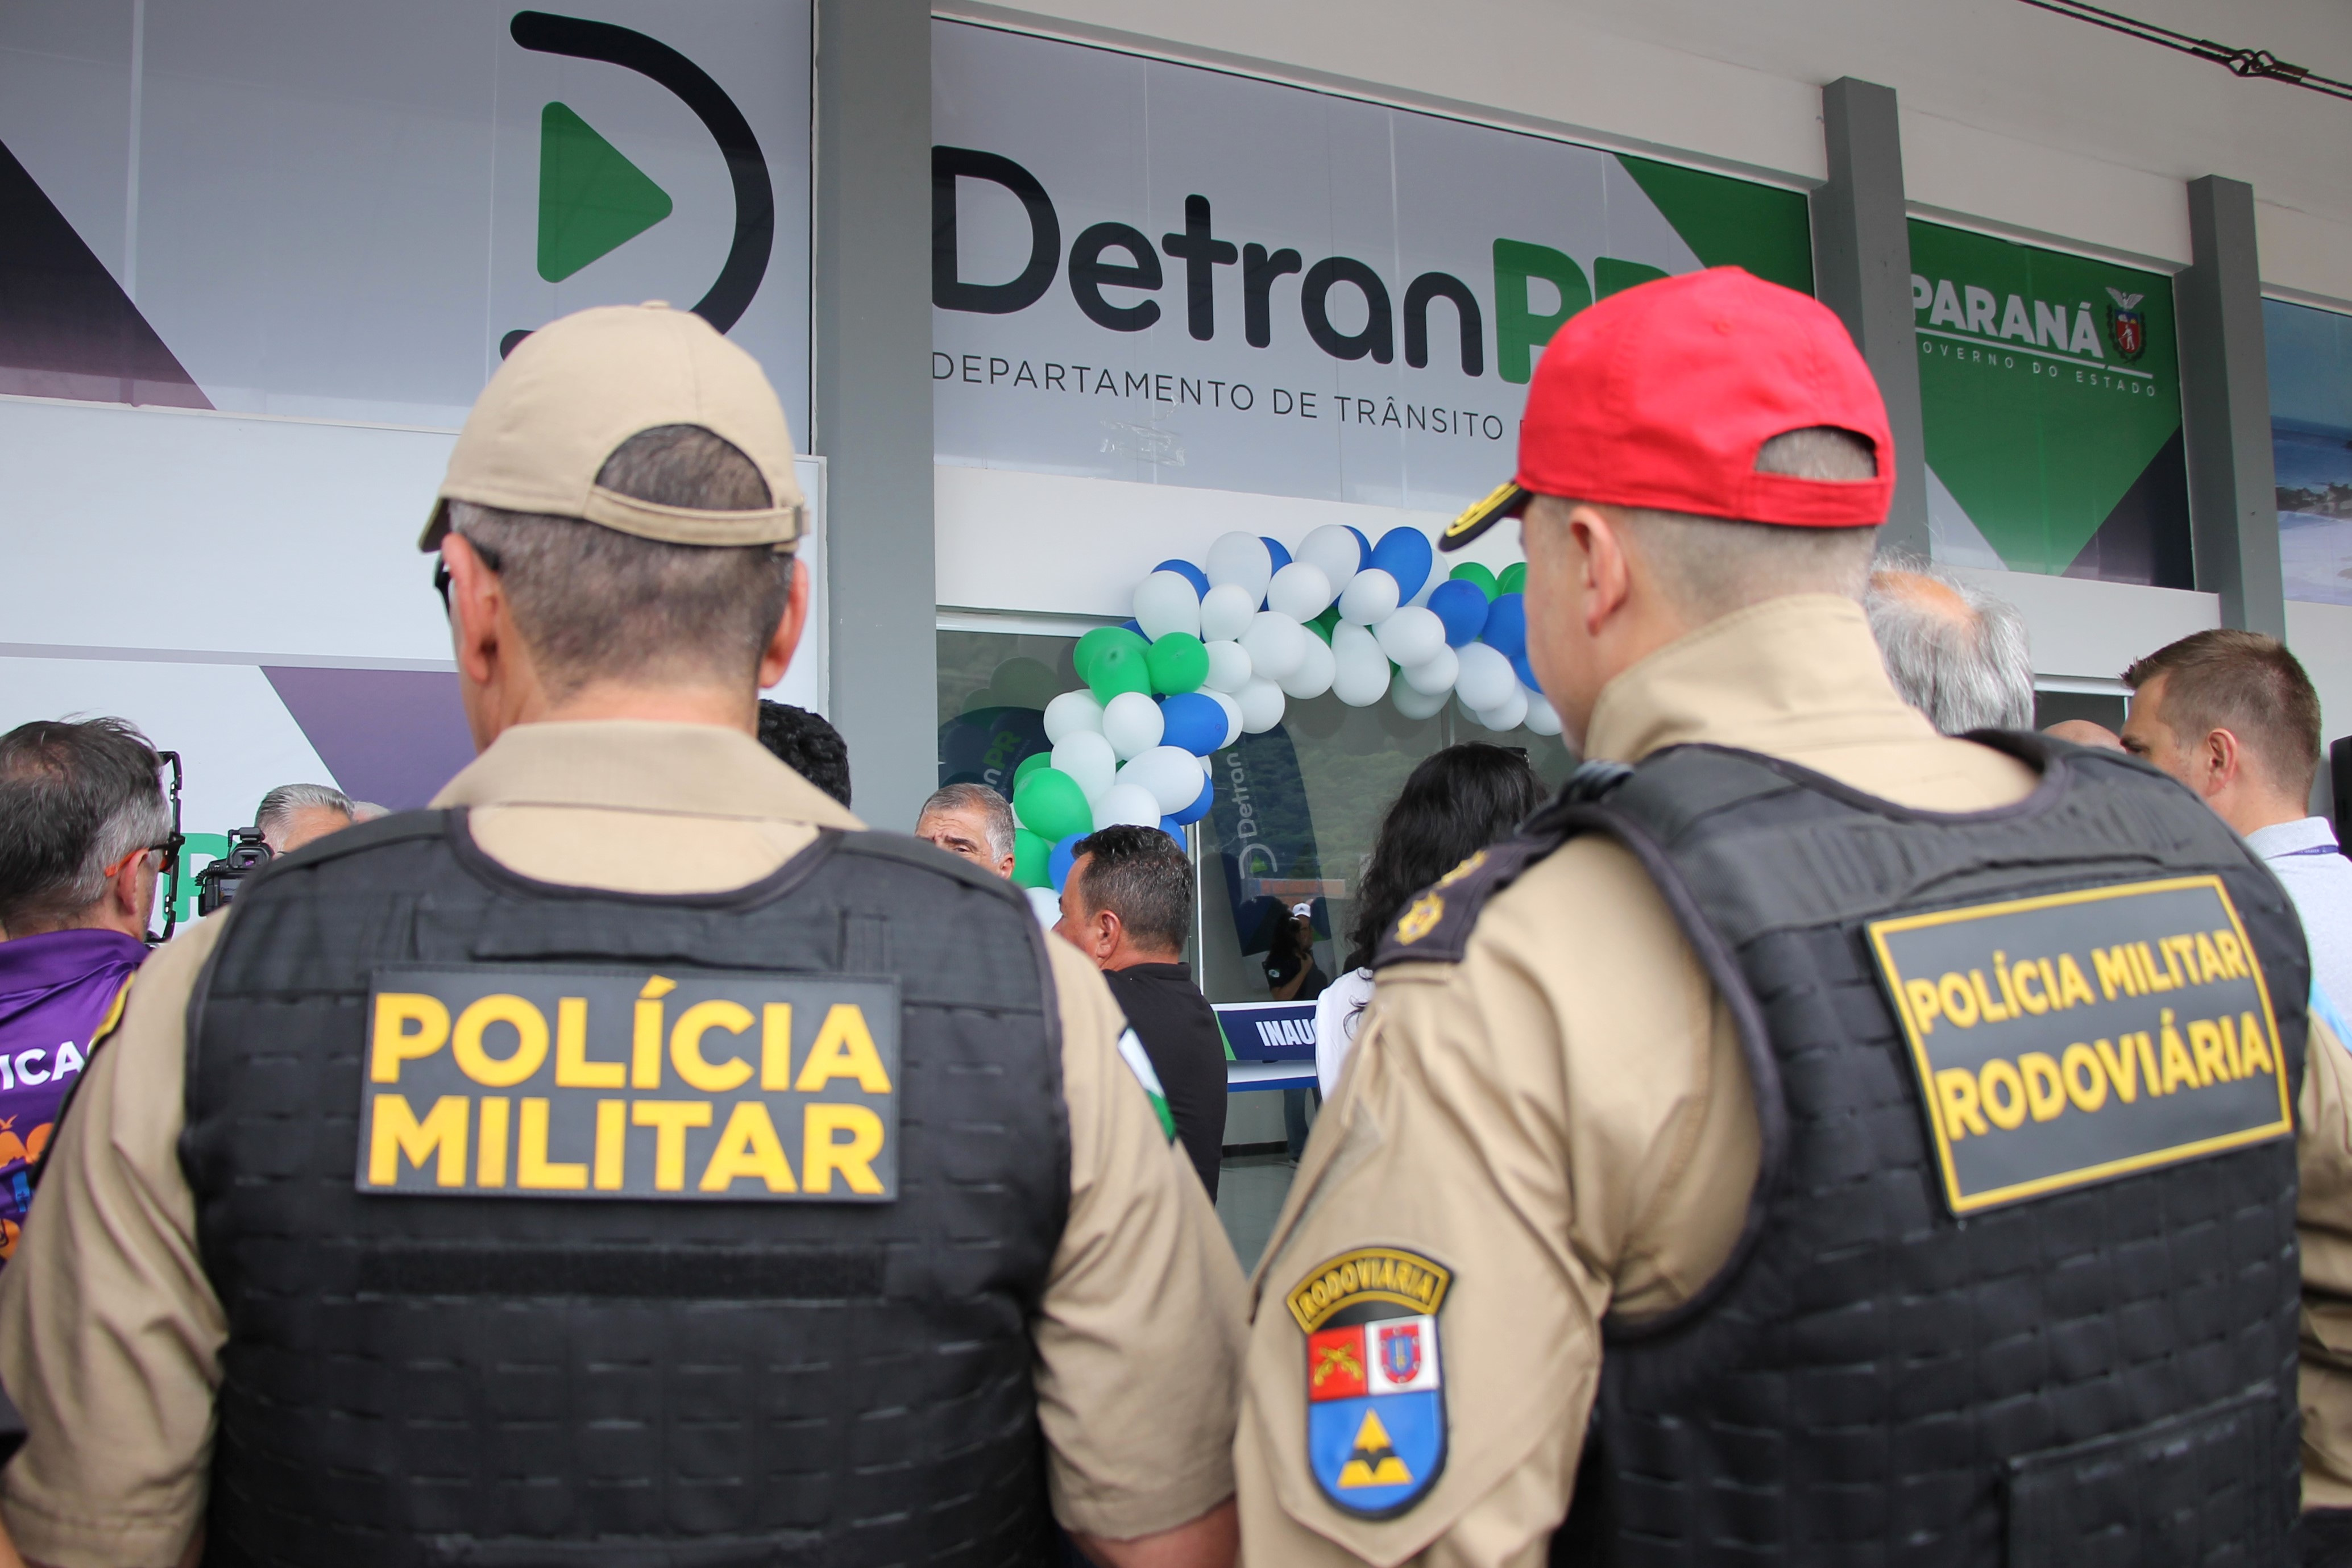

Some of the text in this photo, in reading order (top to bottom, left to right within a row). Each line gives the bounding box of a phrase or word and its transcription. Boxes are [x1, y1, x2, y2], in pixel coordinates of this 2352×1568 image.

[932, 144, 1673, 385] DetranP
[1911, 273, 2104, 358] PARANÁ
[932, 351, 1253, 410] DEPARTAMENTO
[1273, 388, 1318, 419] DE
[1334, 396, 1503, 441] TRÂNSITO
[1923, 342, 2155, 397] OVERNO DO ESTADO
[1226, 746, 1258, 839] Detran
[1906, 930, 2250, 1034] POLÍCIA MILITAR
[0, 1038, 95, 1090] ICA
[370, 974, 893, 1094] POLÍCIA
[1255, 1018, 1317, 1047] INAU
[1935, 1008, 2275, 1141] RODOVIÁRIA
[368, 1093, 885, 1194] MILITAR
